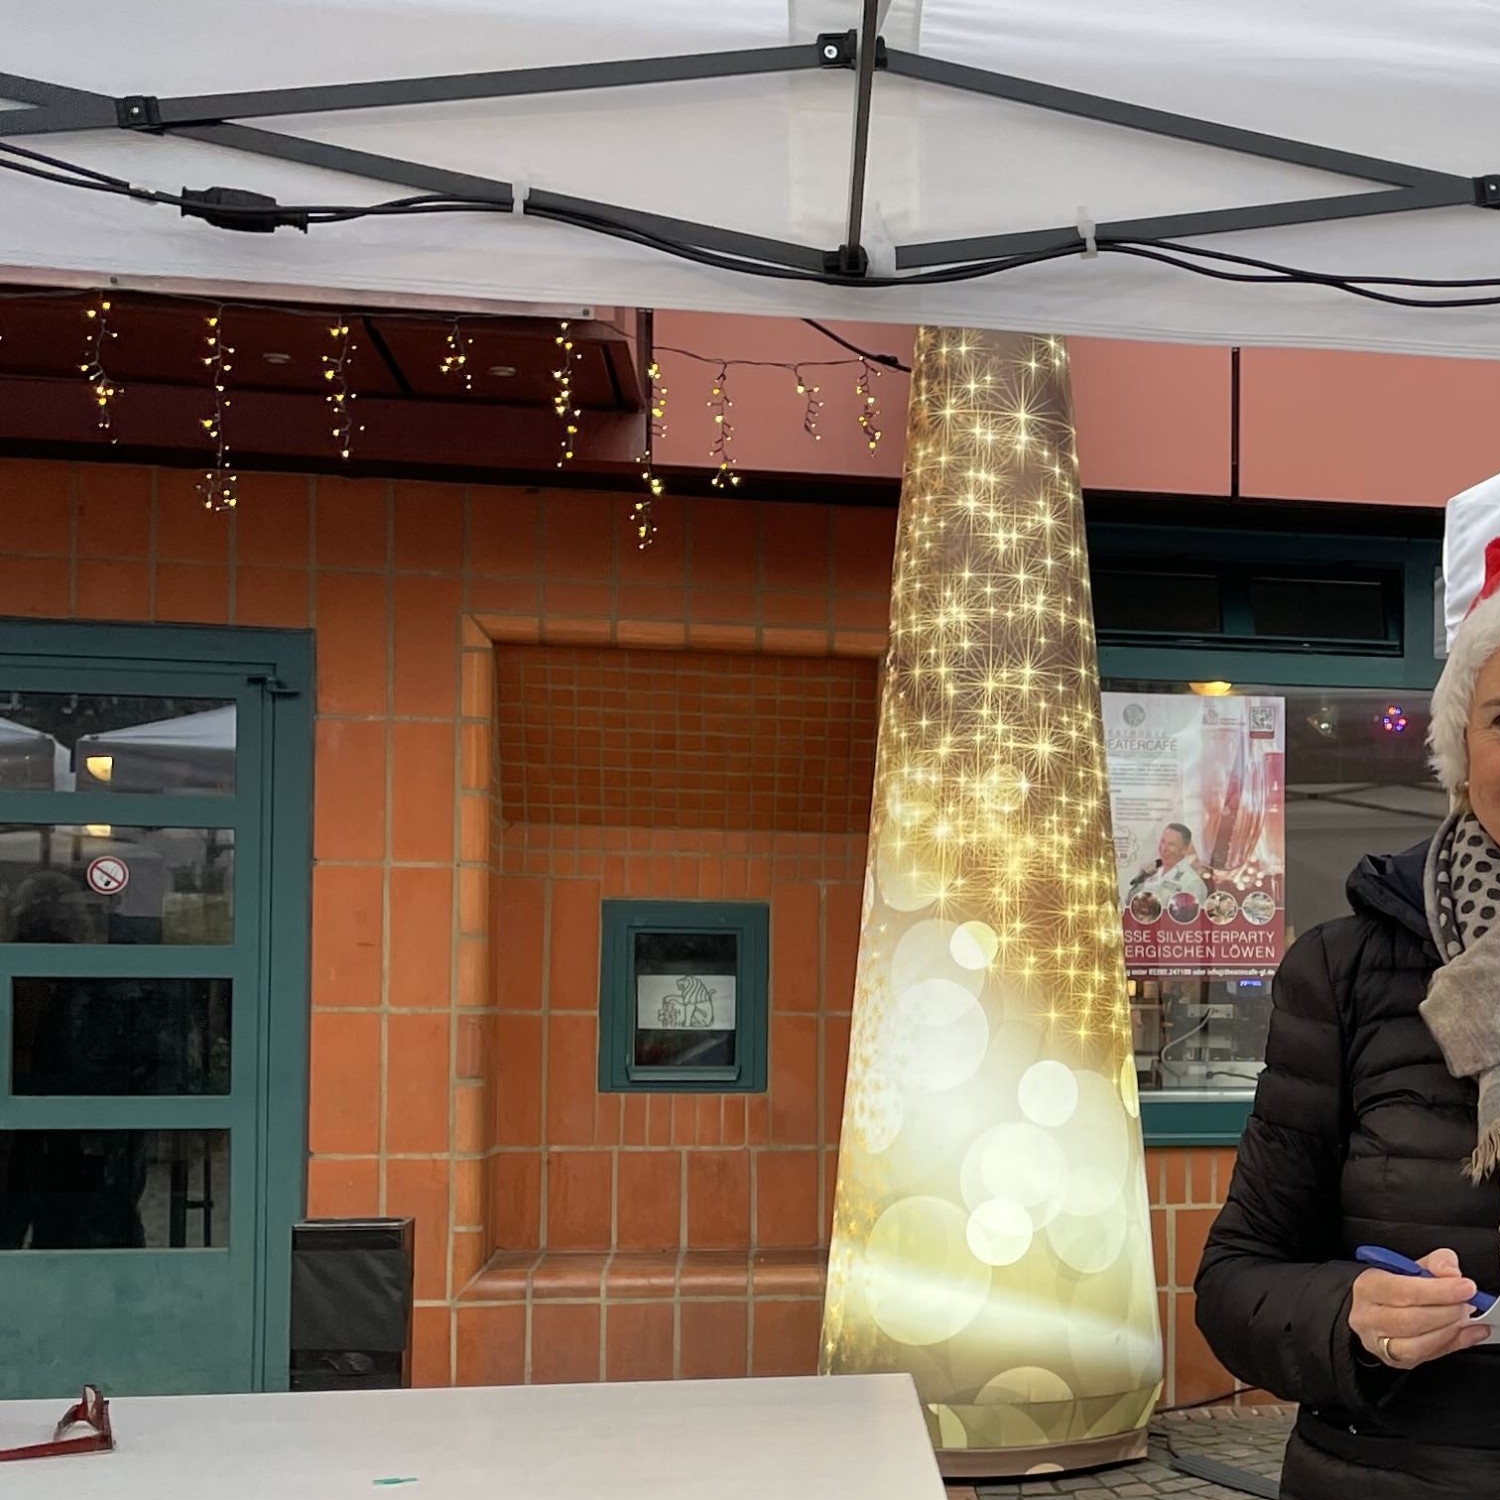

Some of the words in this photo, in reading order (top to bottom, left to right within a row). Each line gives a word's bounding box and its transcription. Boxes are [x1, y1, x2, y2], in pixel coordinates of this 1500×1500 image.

[1107, 738, 1178, 751] EATERCAFÉ
[1124, 930, 1152, 943] SSE
[1156, 930, 1275, 944] SILVESTERPARTY
[1124, 945, 1216, 959] ERGISCHEN
[1221, 944, 1275, 959] LÖWEN
